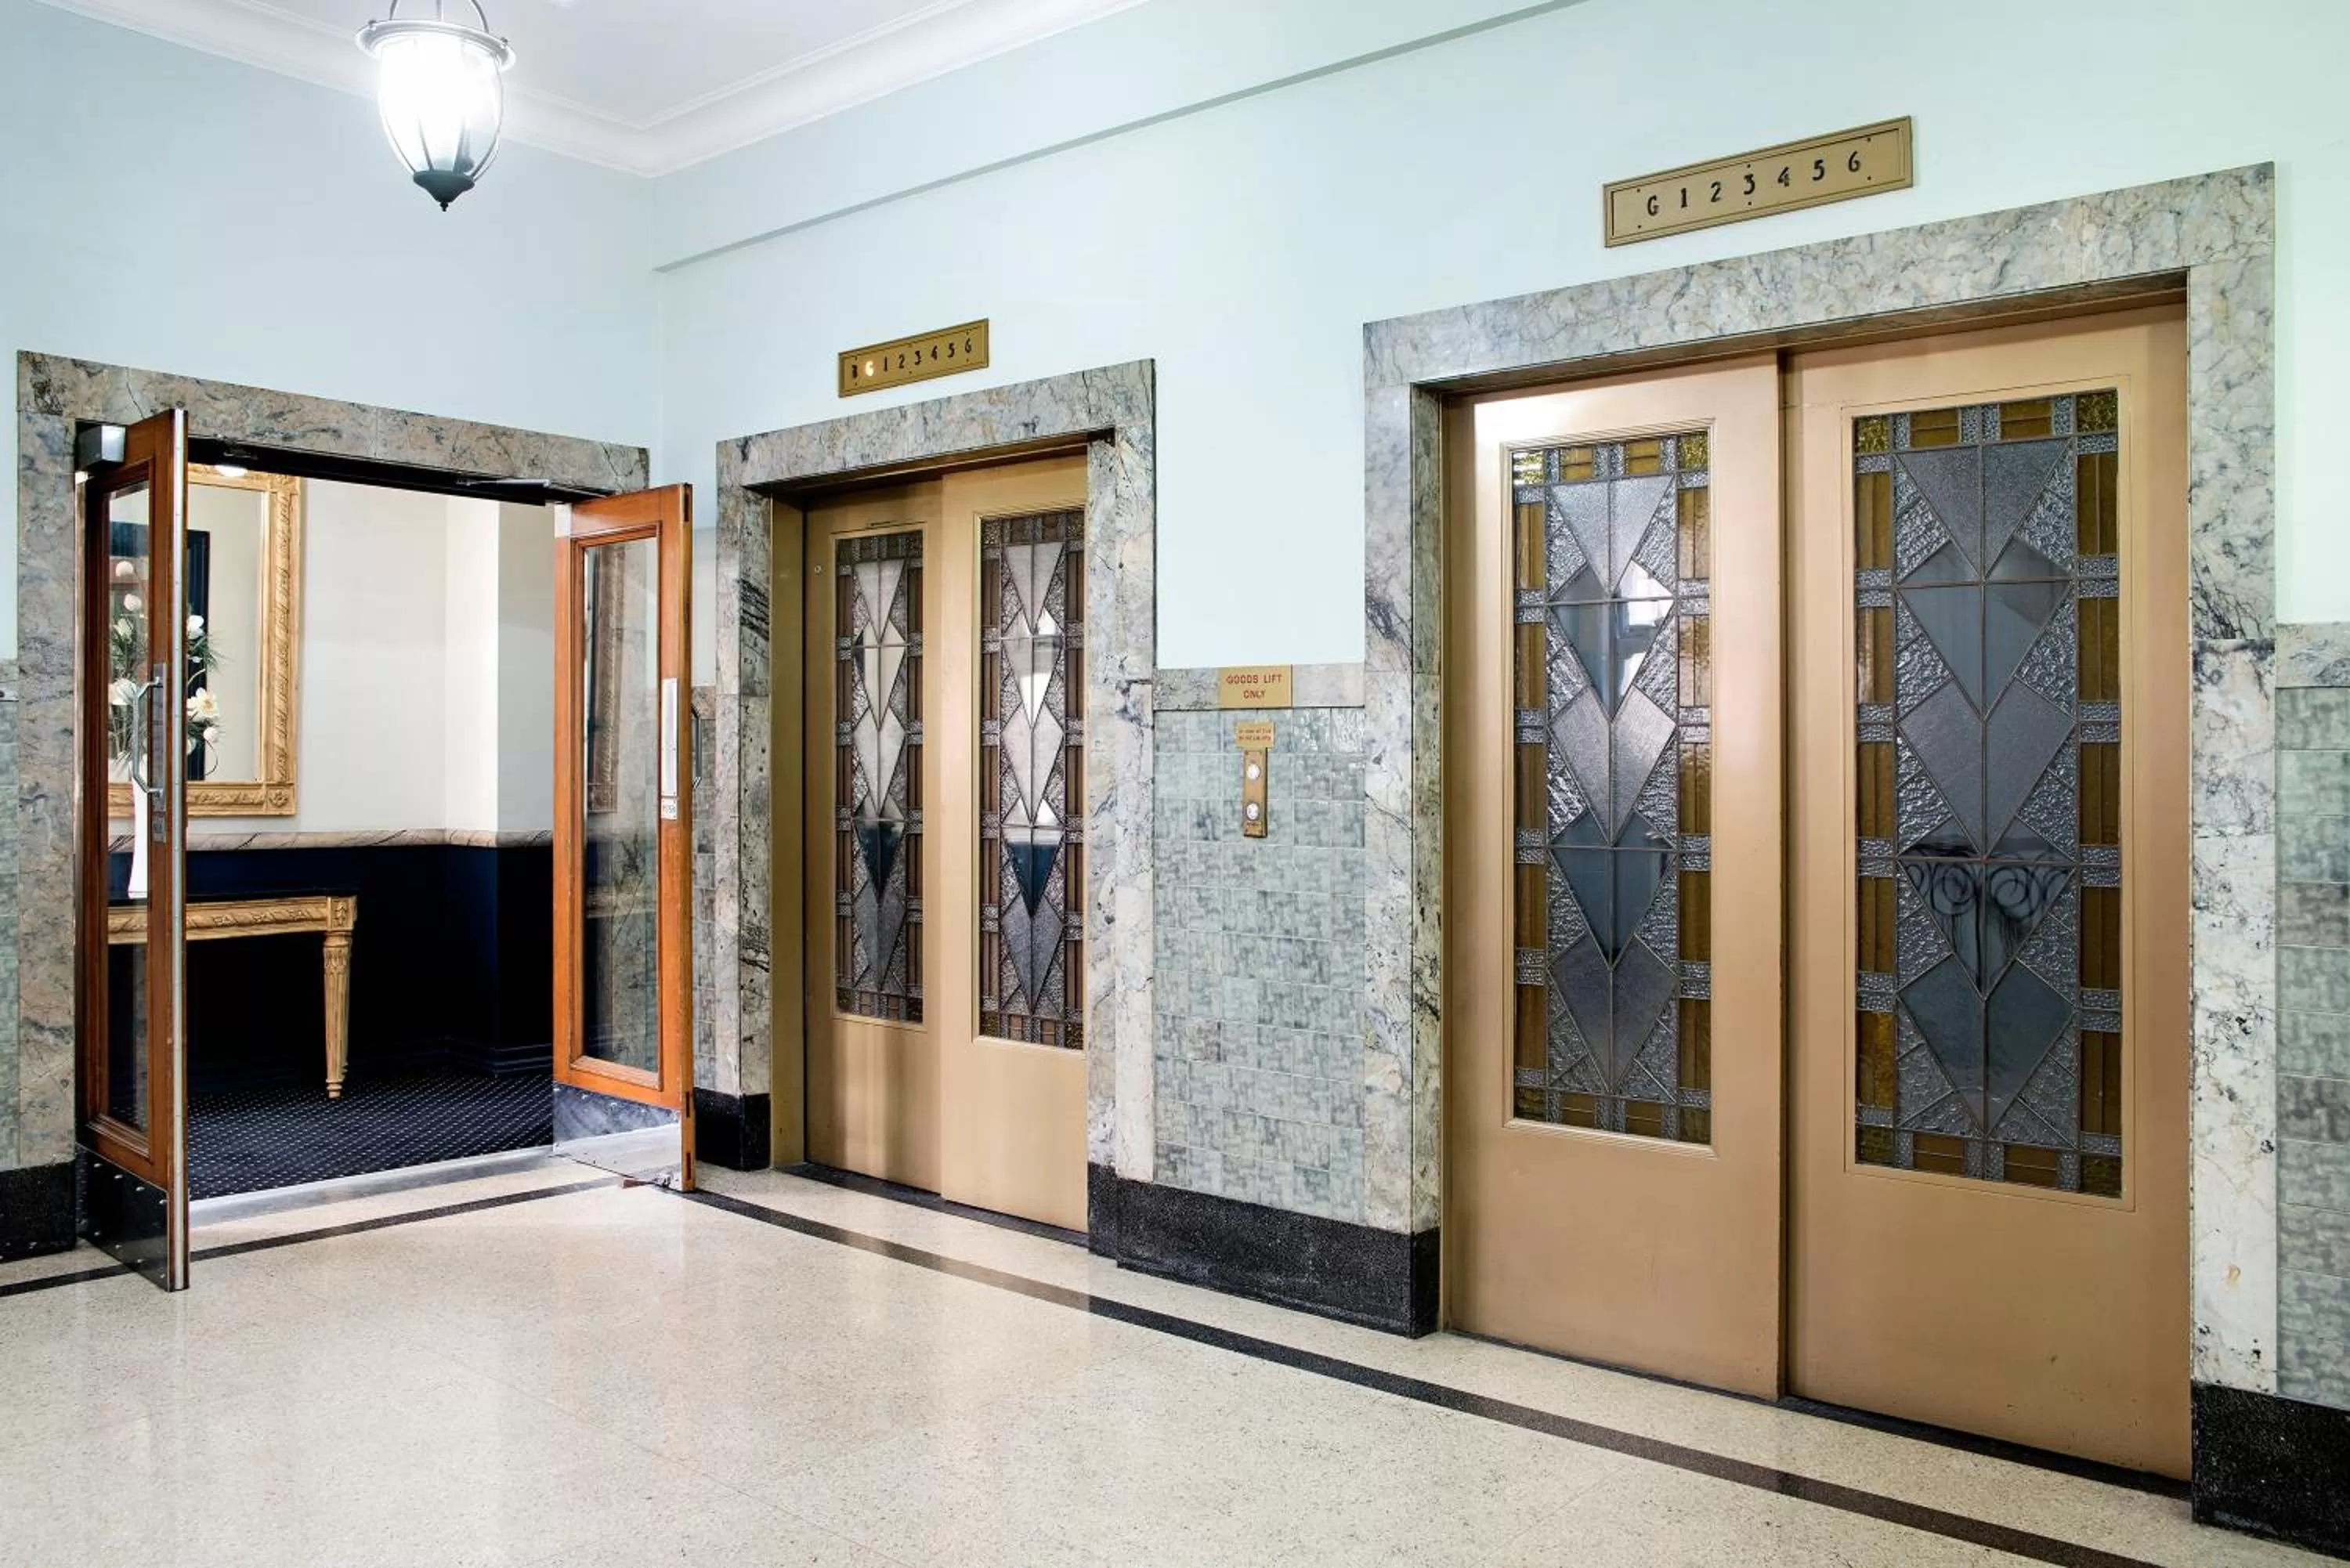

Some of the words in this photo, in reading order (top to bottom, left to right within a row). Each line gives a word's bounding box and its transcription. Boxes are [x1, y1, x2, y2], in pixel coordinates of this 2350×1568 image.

[1647, 195, 1659, 216] G
[1680, 188, 1687, 208] 1
[1711, 181, 1721, 203] 2
[1744, 173, 1755, 195] 3
[1777, 167, 1790, 187] 4
[1813, 159, 1824, 181] 5
[1849, 150, 1860, 172] 6
[884, 357, 888, 372] 1
[898, 354, 905, 369] 2
[914, 351, 921, 366] 3
[931, 346, 938, 360] 4
[947, 342, 954, 358] 5
[964, 338, 971, 353] 6
[1226, 674, 1259, 685] GOODS
[1264, 674, 1282, 684] LIFT
[1243, 689, 1266, 699] ONLY
